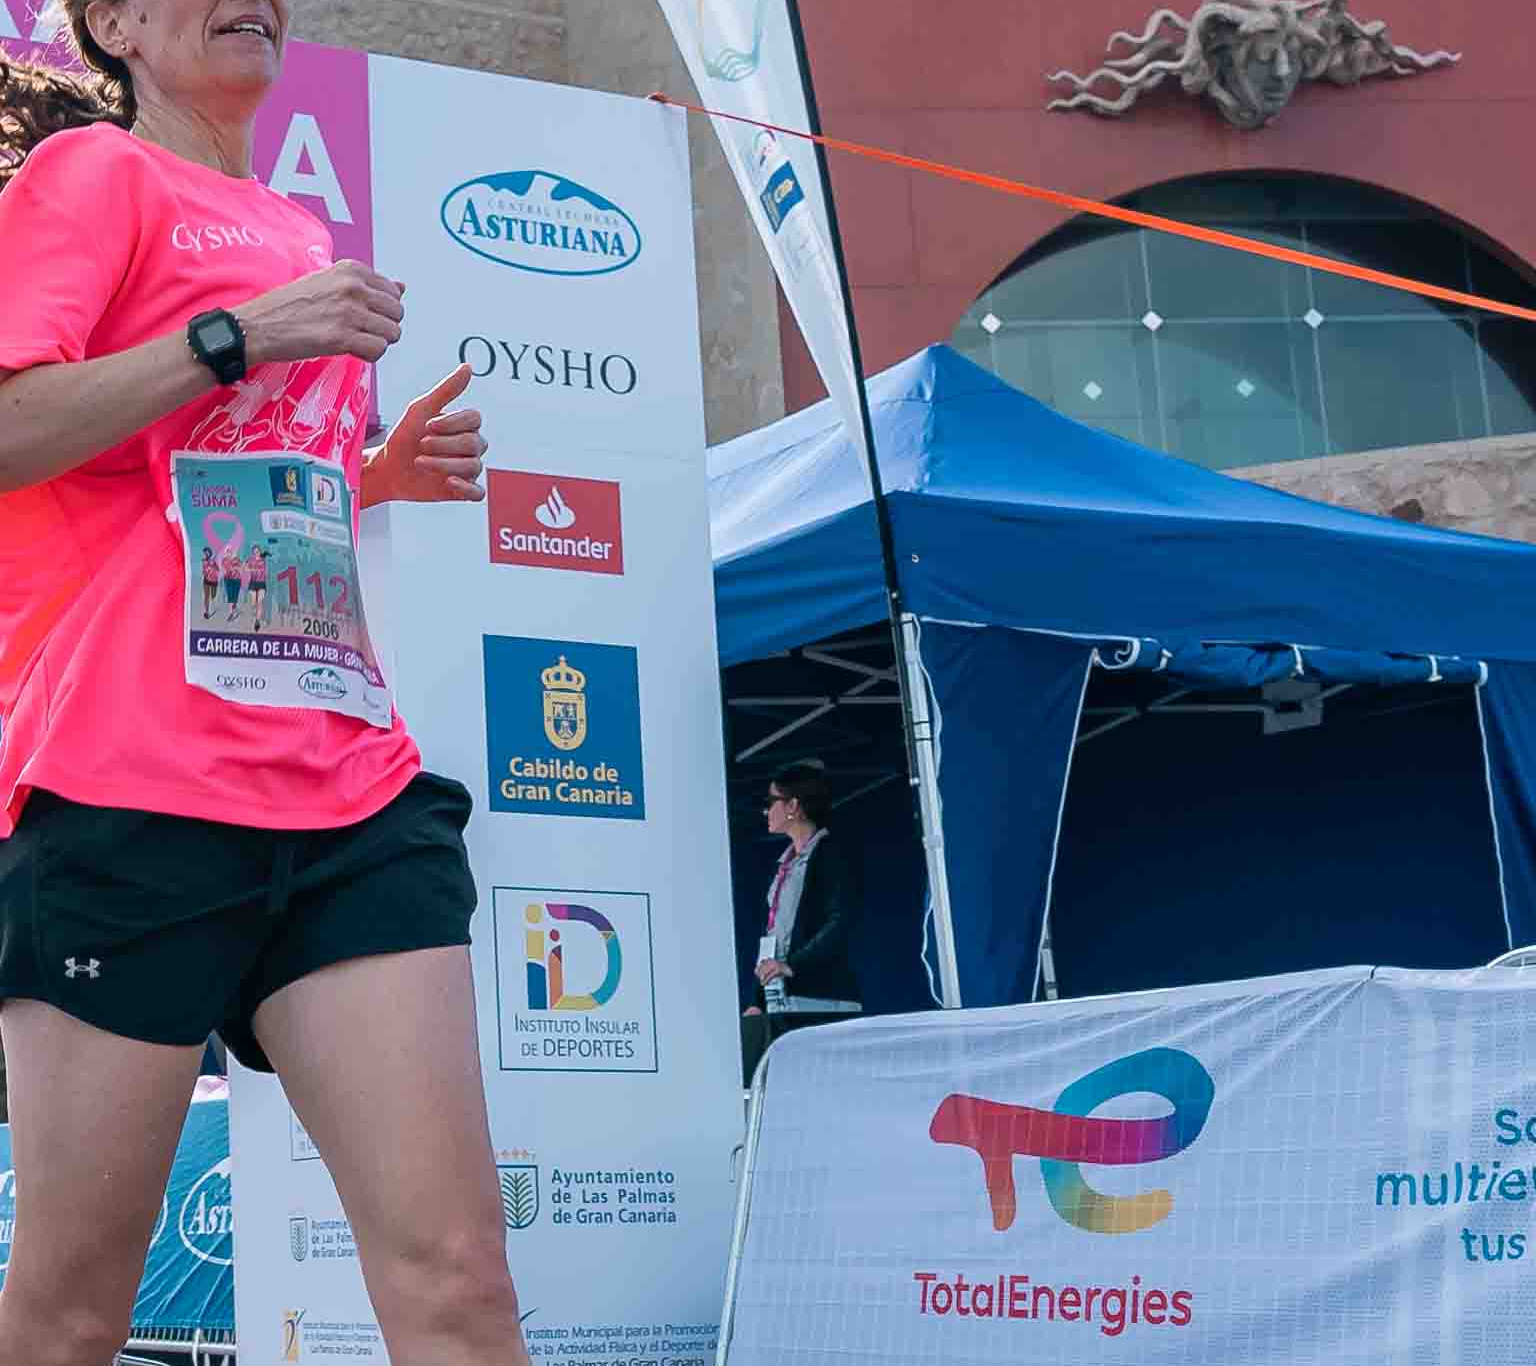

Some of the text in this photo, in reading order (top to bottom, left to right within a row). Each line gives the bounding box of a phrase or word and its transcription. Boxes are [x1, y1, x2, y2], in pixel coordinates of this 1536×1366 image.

[457, 197, 627, 258] ASTURIANA
[458, 336, 637, 395] OYSHO
[499, 527, 612, 562] Santander
[197, 637, 258, 655] CARRERA
[263, 641, 280, 656] DE
[283, 642, 300, 657] LA
[510, 757, 618, 783] Cabildo de
[500, 778, 633, 806] Gran Canaria
[514, 1015, 639, 1035] INSTITUTO INSULAR
[521, 1039, 634, 1058] DE DEPORTES
[551, 1169, 674, 1188] Ayuntamiento
[552, 1188, 675, 1204] de Las Palmas
[552, 1208, 676, 1223] de Gran Canaria
[1460, 1226, 1524, 1263] tus
[914, 1272, 1193, 1336] TotalEnergies
